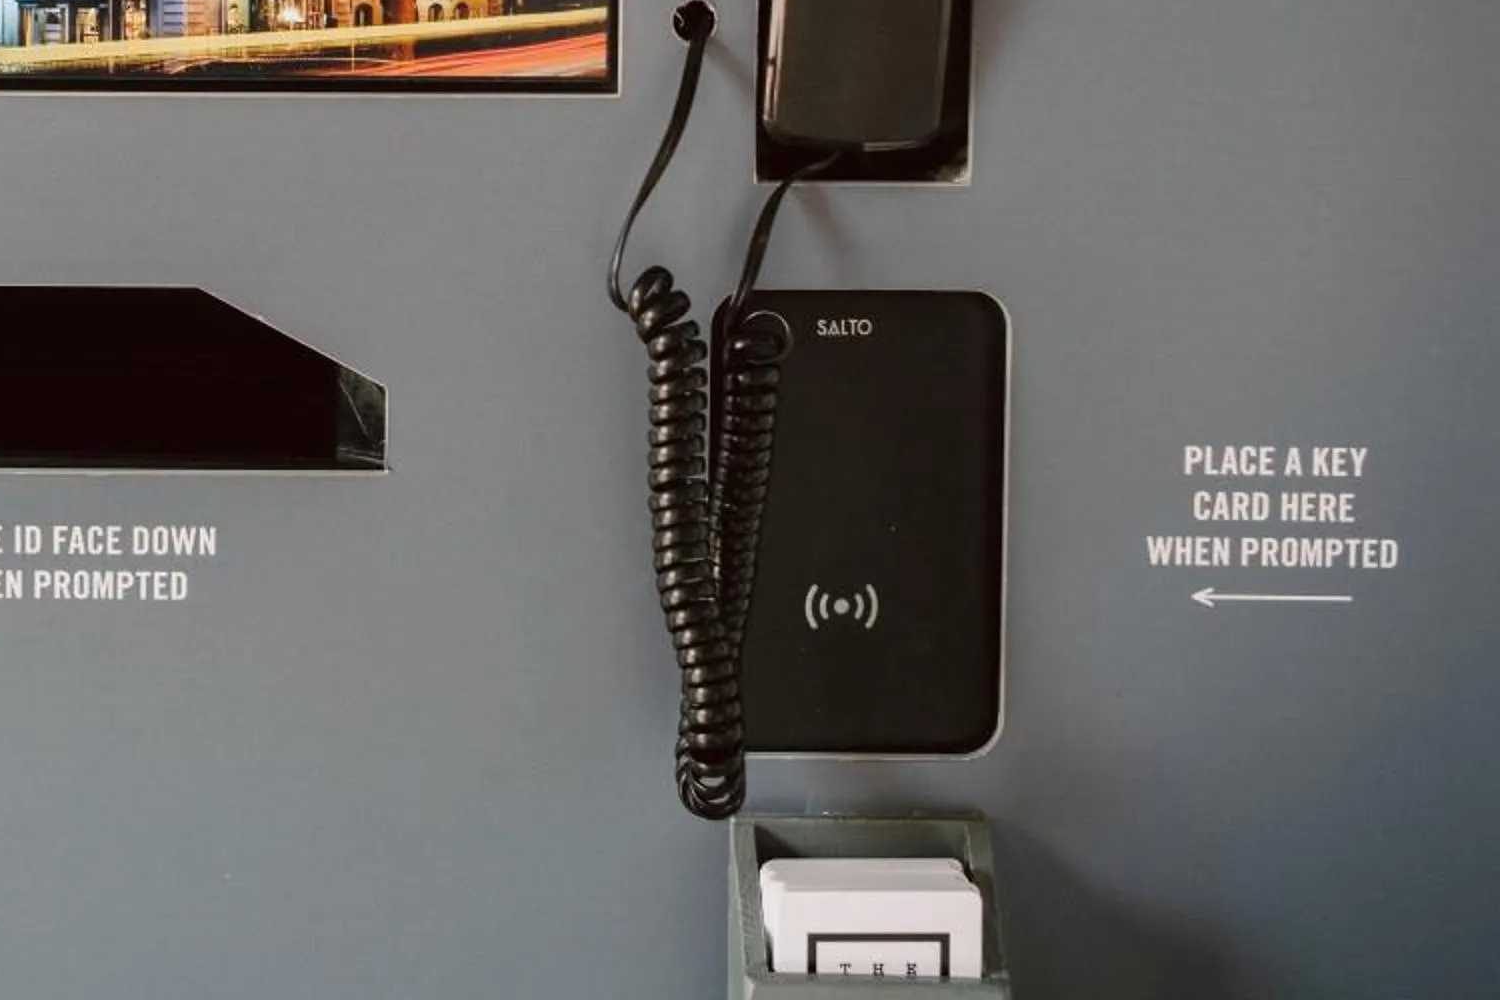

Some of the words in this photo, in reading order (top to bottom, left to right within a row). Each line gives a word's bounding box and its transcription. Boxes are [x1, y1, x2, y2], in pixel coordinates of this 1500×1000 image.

[816, 318, 874, 337] SALTO
[1184, 445, 1276, 477] PLACE
[1284, 446, 1303, 477] A
[1312, 447, 1368, 477] KEY
[1192, 490, 1270, 522] CARD
[1280, 491, 1356, 523] HERE
[13, 525, 42, 555] ID
[52, 525, 123, 555] FACE
[131, 525, 218, 556] DOWN
[1146, 535, 1231, 568] WHEN
[1240, 537, 1399, 570] PROMPTED
[33, 570, 189, 601] PROMPTED
